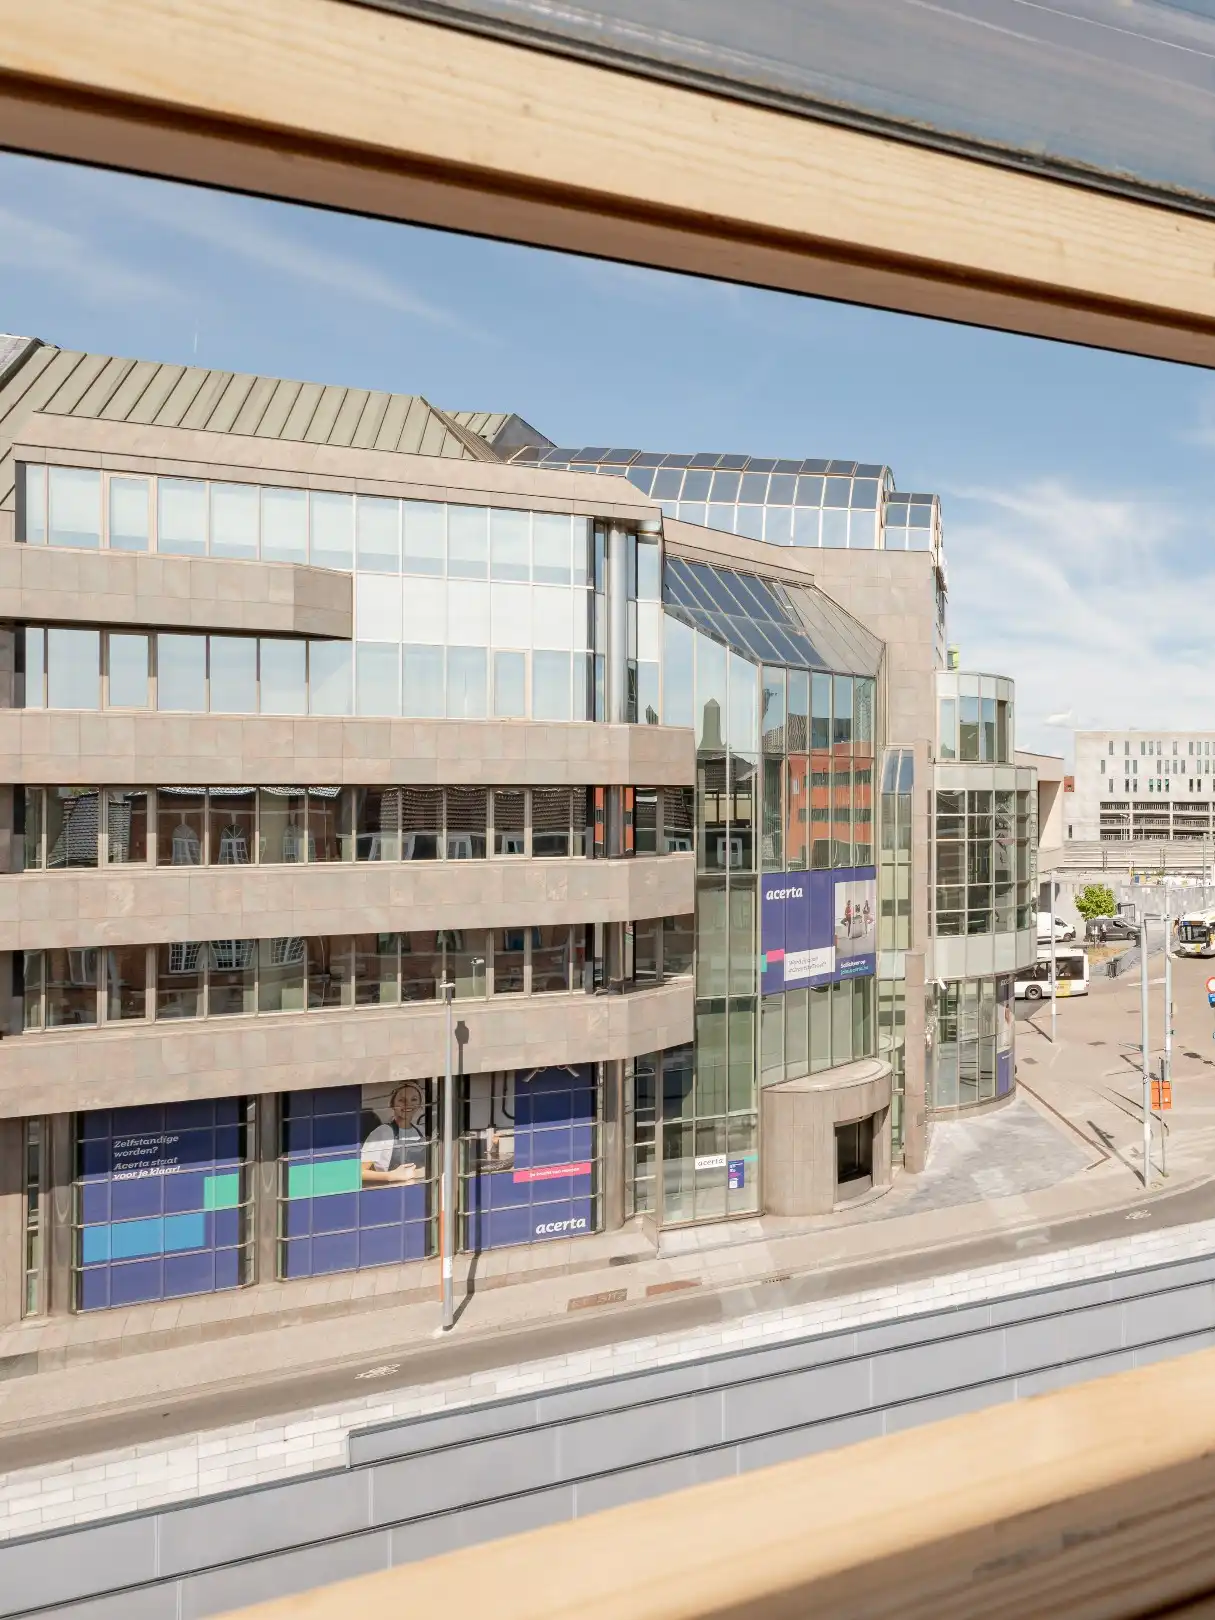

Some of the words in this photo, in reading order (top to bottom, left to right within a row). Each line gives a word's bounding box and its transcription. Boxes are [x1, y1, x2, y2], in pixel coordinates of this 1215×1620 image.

[766, 886, 803, 901] acerta
[113, 1135, 179, 1149] Zelfstandige
[113, 1146, 159, 1158] worden?
[113, 1159, 150, 1171] Acerta
[151, 1156, 179, 1167] staat
[698, 1158, 724, 1167] acerta
[112, 1171, 138, 1181] voor
[138, 1169, 149, 1179] je
[149, 1165, 181, 1176] klaar!
[535, 1217, 586, 1235] acerta
